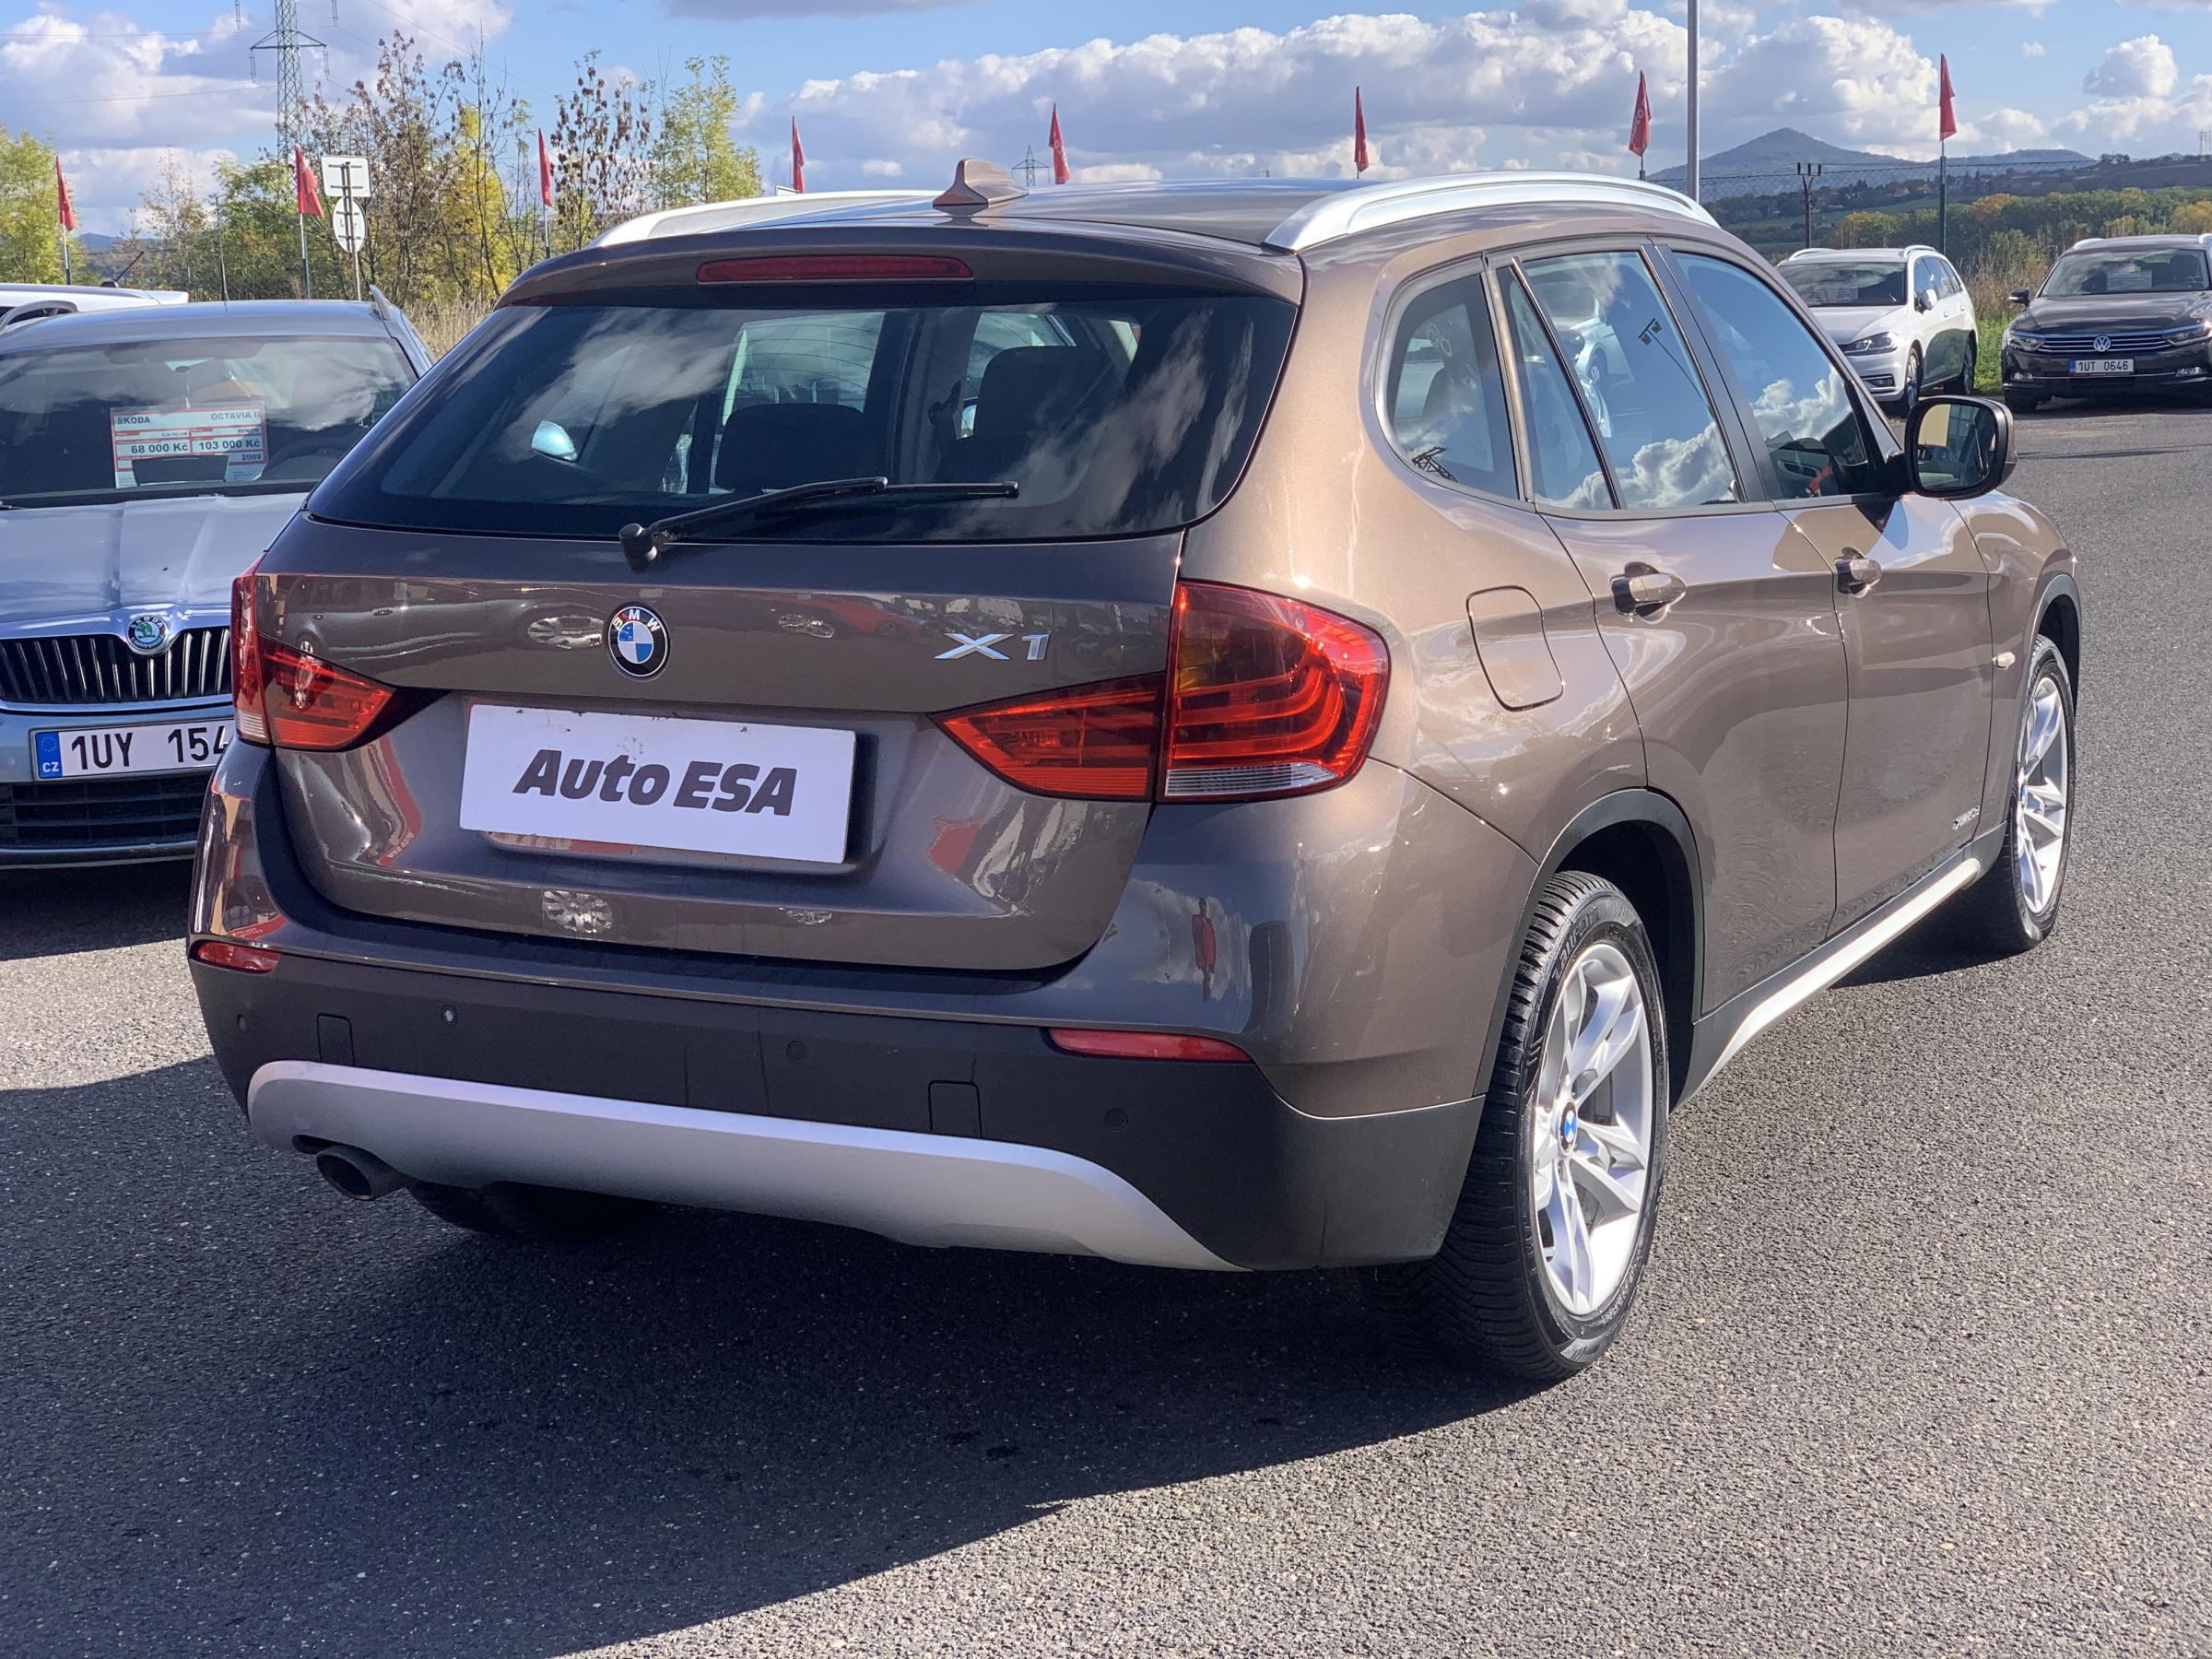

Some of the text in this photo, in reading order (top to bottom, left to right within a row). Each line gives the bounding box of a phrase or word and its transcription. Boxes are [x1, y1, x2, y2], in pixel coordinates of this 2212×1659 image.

[2078, 361, 2096, 371] 1UT
[2103, 361, 2129, 371] 0646
[211, 411, 252, 420] OCTAVIA
[131, 442, 189, 453] 68 000 Kč
[199, 437, 261, 450] 103 000 Kč
[241, 453, 262, 461] 2009
[612, 609, 661, 632] BMW
[934, 633, 1050, 661] X1
[42, 761, 60, 773] CZ
[71, 732, 134, 771] 1UY
[512, 748, 798, 818] Auto ESA
